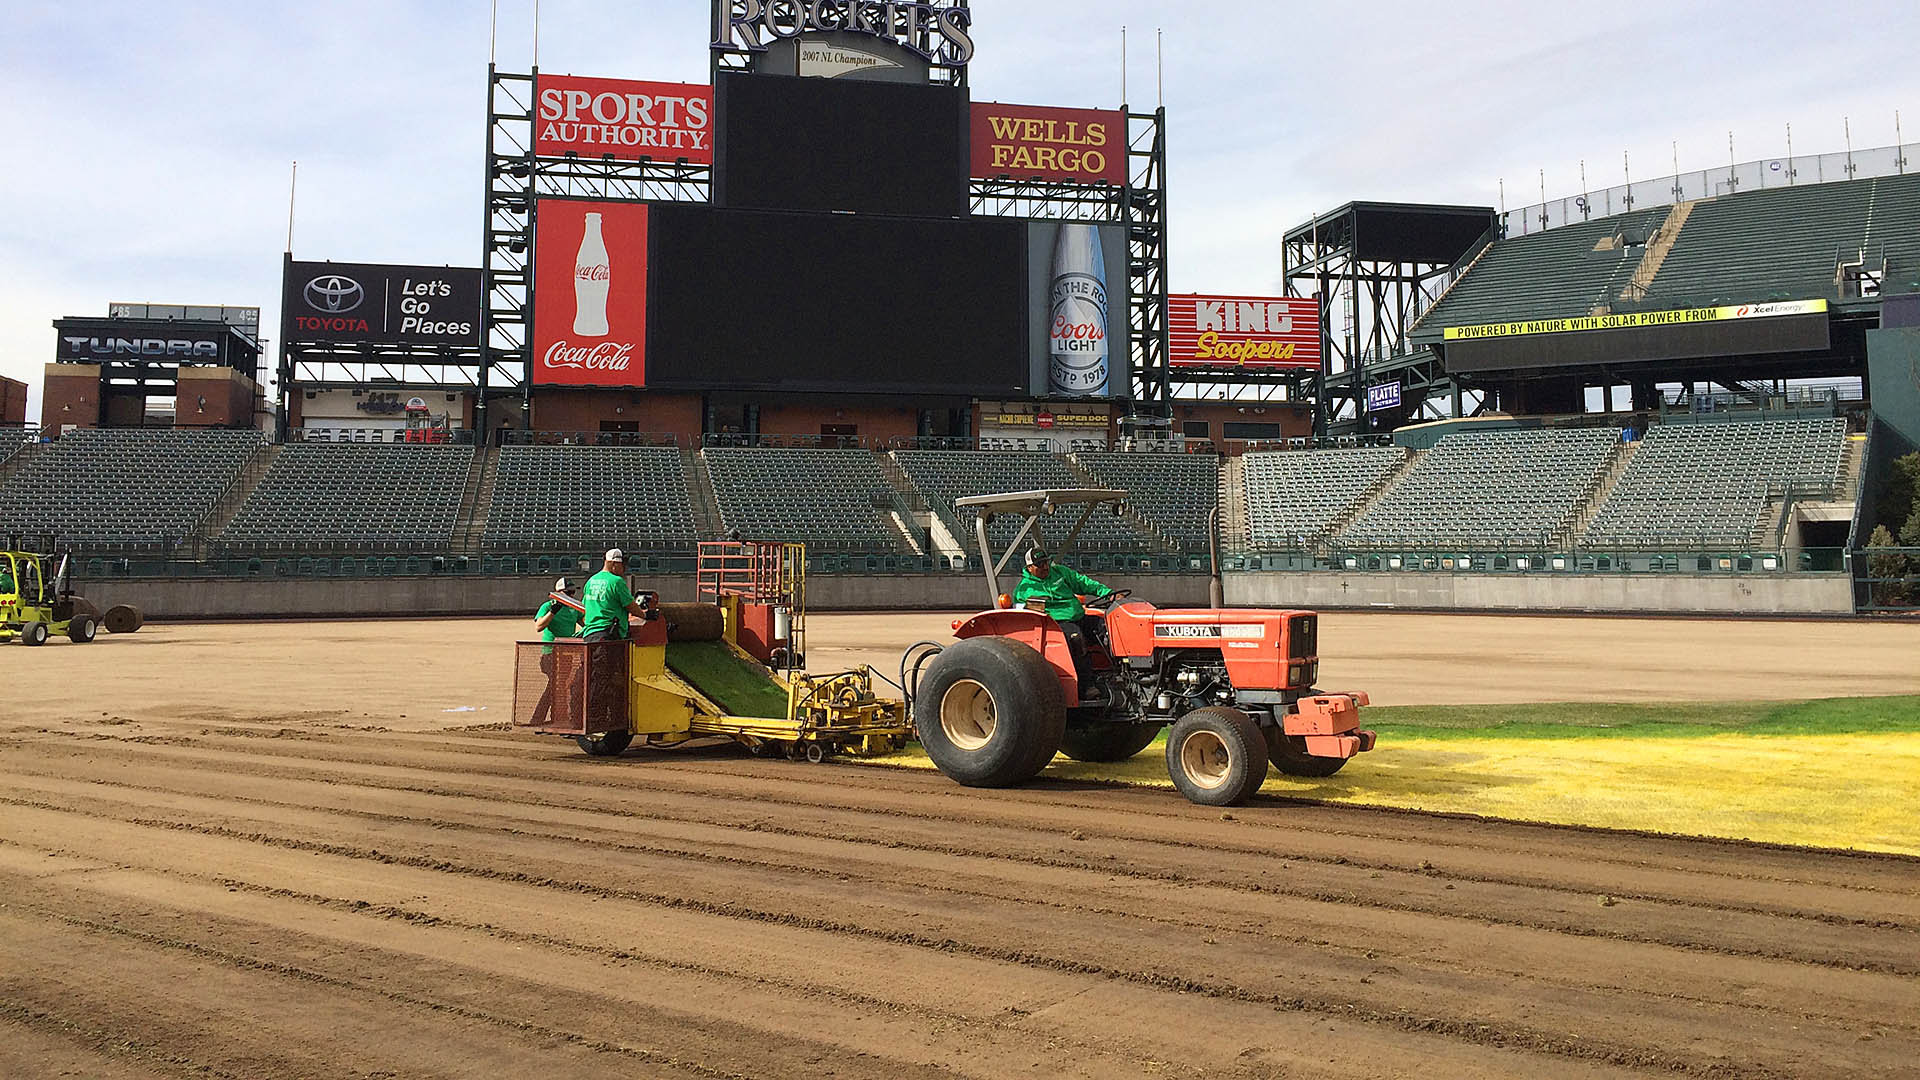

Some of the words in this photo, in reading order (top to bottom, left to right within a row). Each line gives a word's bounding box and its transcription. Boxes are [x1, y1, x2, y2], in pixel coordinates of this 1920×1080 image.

[709, 0, 975, 66] ROCKIES
[801, 50, 820, 61] 2007
[821, 51, 834, 63] NL
[834, 52, 877, 67] Champions
[540, 88, 708, 129] SPORTS
[539, 122, 707, 150] AUTHORITY
[988, 117, 1106, 146] WELLS
[991, 144, 1106, 173] FARGO
[402, 279, 452, 297] Let's
[1063, 281, 1089, 294] THE
[401, 297, 430, 315] Go
[1195, 301, 1293, 333] KING
[296, 316, 369, 332] TOYOTA
[401, 317, 471, 335] Places
[1051, 315, 1105, 340] Coors
[1457, 325, 1507, 338] POWERED
[1510, 323, 1523, 334] BY
[1527, 320, 1567, 333] NATURE
[1570, 317, 1598, 330] WITH
[1602, 314, 1637, 328] SOLAR
[1641, 311, 1681, 325] POWER
[1685, 308, 1718, 321] FROM
[63, 335, 217, 357] TUNDRA
[543, 339, 636, 371] Coca-Cola
[1057, 340, 1097, 351] LIGHT
[1195, 331, 1295, 365] Soopers
[1083, 364, 1106, 384] 1978
[1370, 385, 1399, 403] PLATTE
[1168, 626, 1212, 637] KUBOTA
